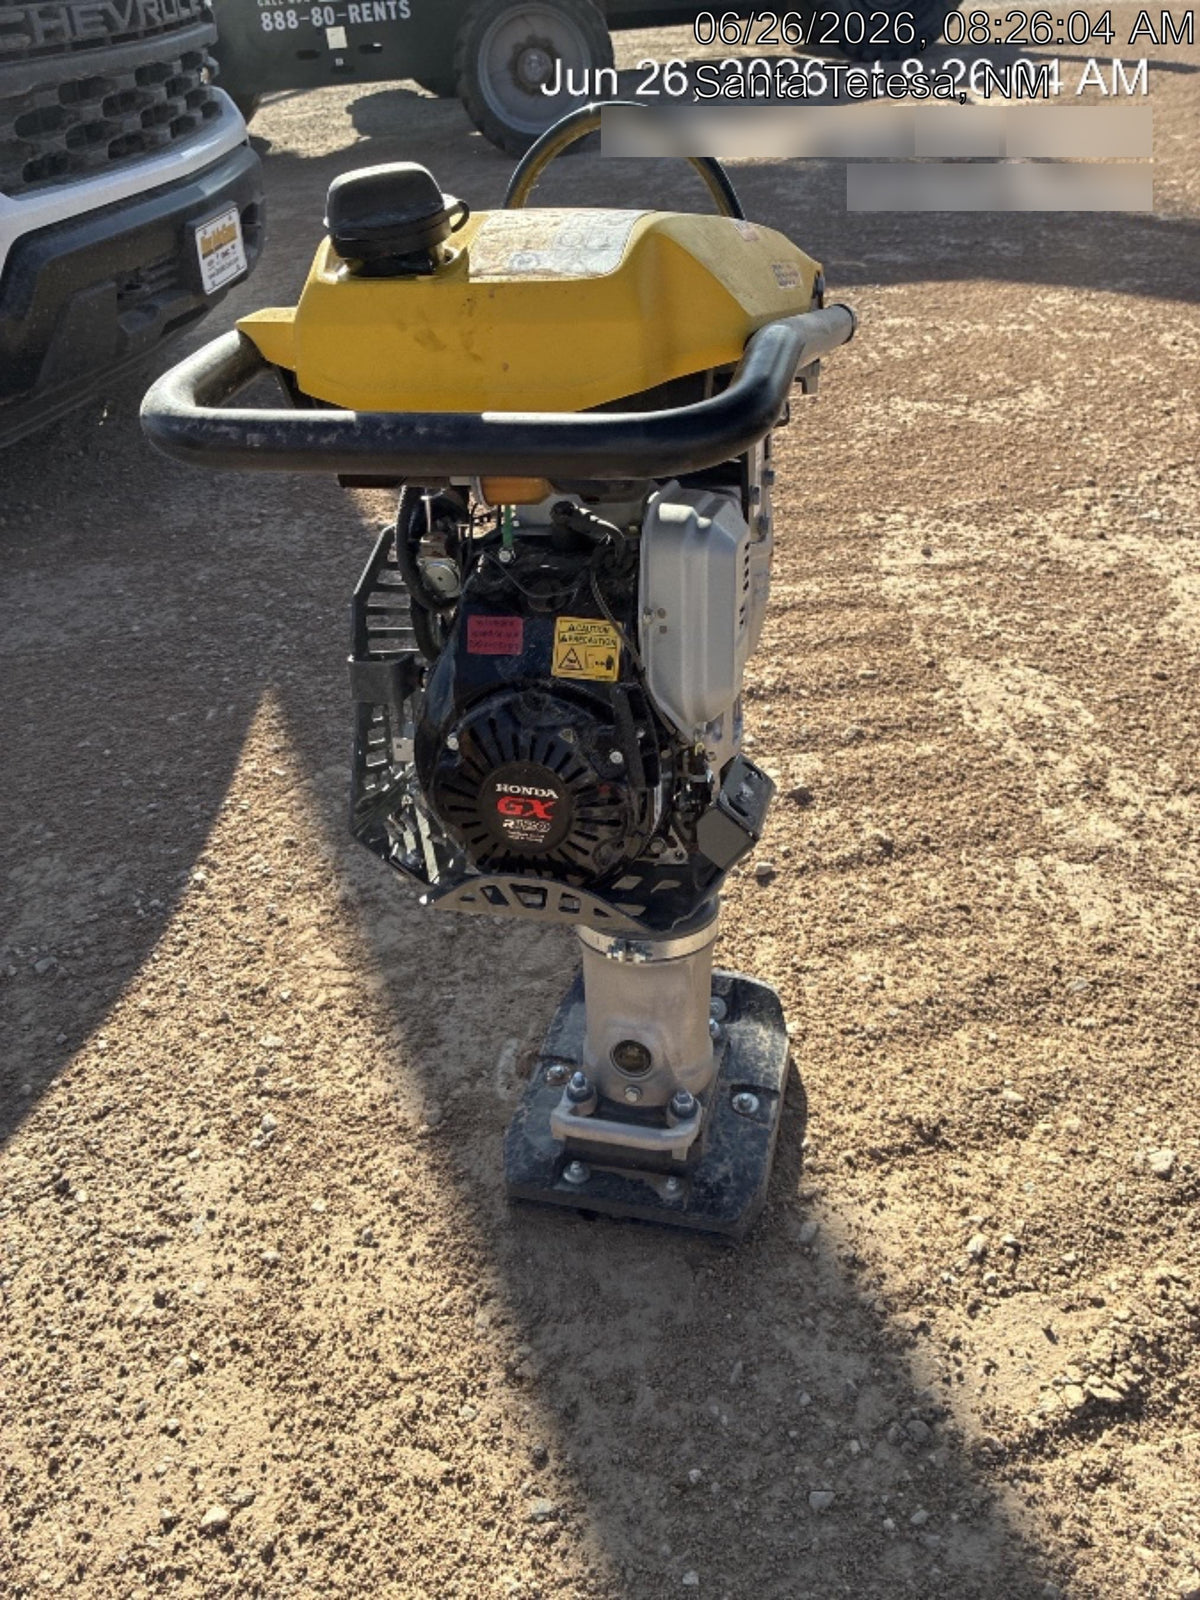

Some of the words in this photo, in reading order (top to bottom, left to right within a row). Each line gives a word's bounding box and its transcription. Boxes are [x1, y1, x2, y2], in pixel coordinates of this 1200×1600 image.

[260, 0, 411, 31] 888-80-RENTS
[496, 783, 559, 799] HONDA
[497, 796, 556, 820] GX
